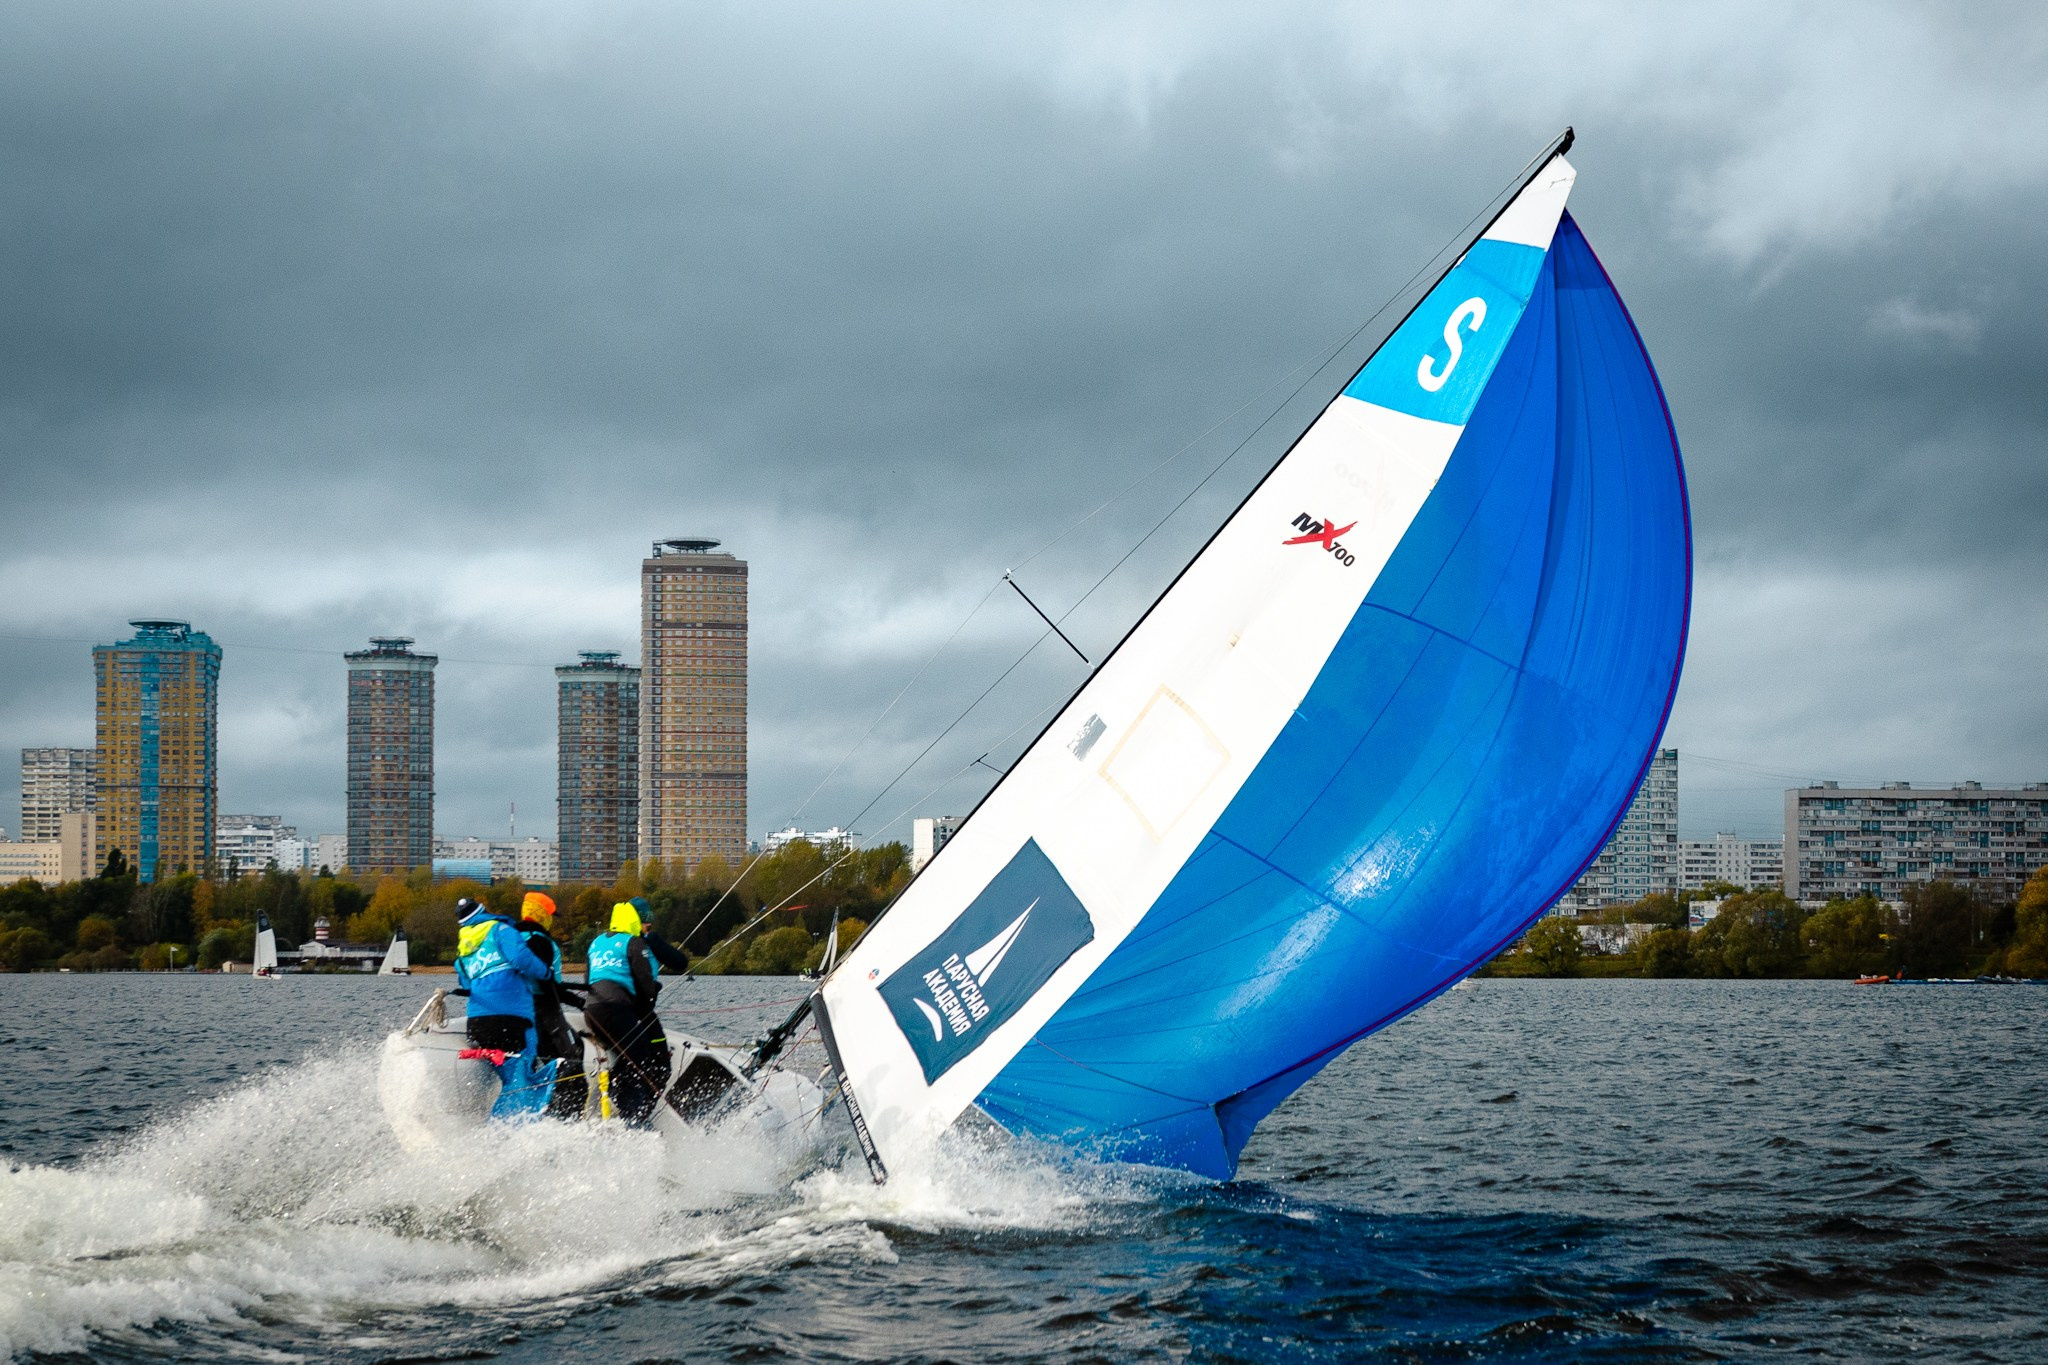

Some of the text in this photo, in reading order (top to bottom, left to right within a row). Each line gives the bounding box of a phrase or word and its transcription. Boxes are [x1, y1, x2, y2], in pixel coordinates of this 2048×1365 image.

[1417, 296, 1488, 392] S
[1327, 541, 1356, 567] 700
[922, 968, 972, 1037] АКАДЕМИЯ
[942, 953, 990, 1022] ПАРУСНАЯ
